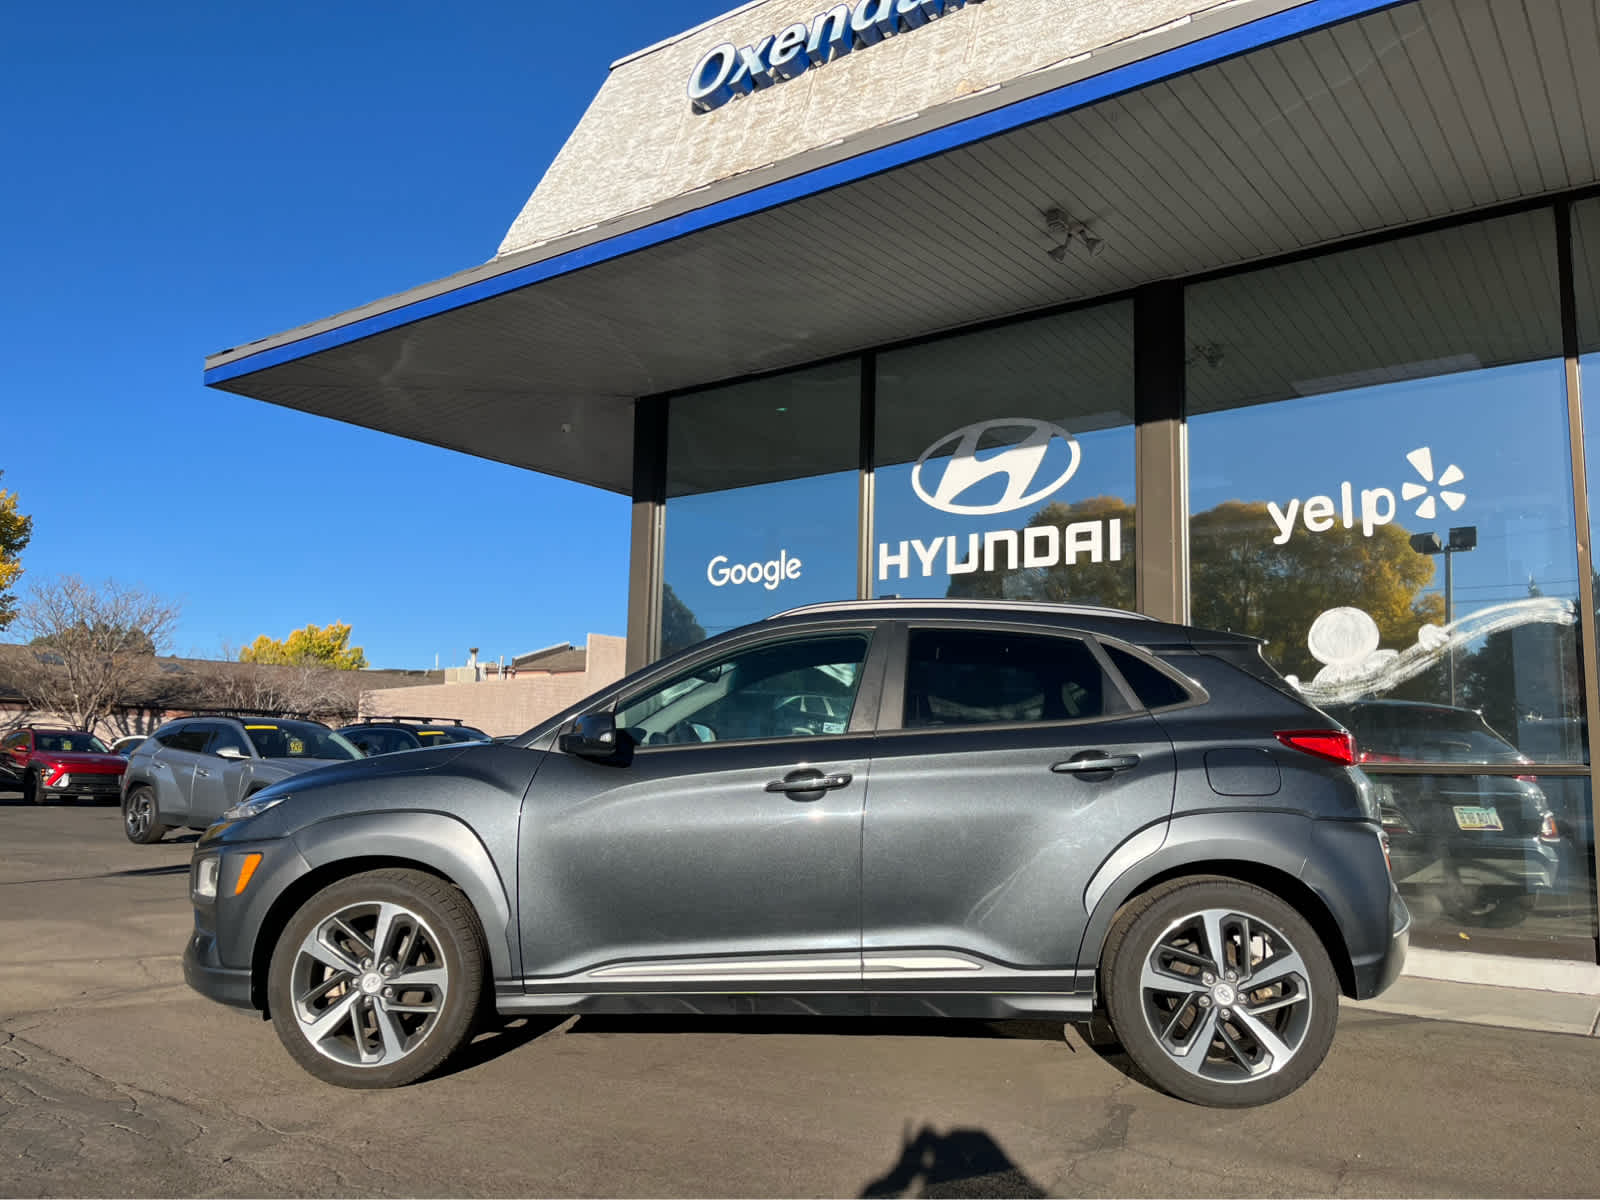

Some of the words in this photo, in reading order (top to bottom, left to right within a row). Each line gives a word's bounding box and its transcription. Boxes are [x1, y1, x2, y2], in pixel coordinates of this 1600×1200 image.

[1267, 481, 1396, 545] yelp
[707, 549, 802, 590] Google
[879, 518, 1121, 580] HYUNDAI
